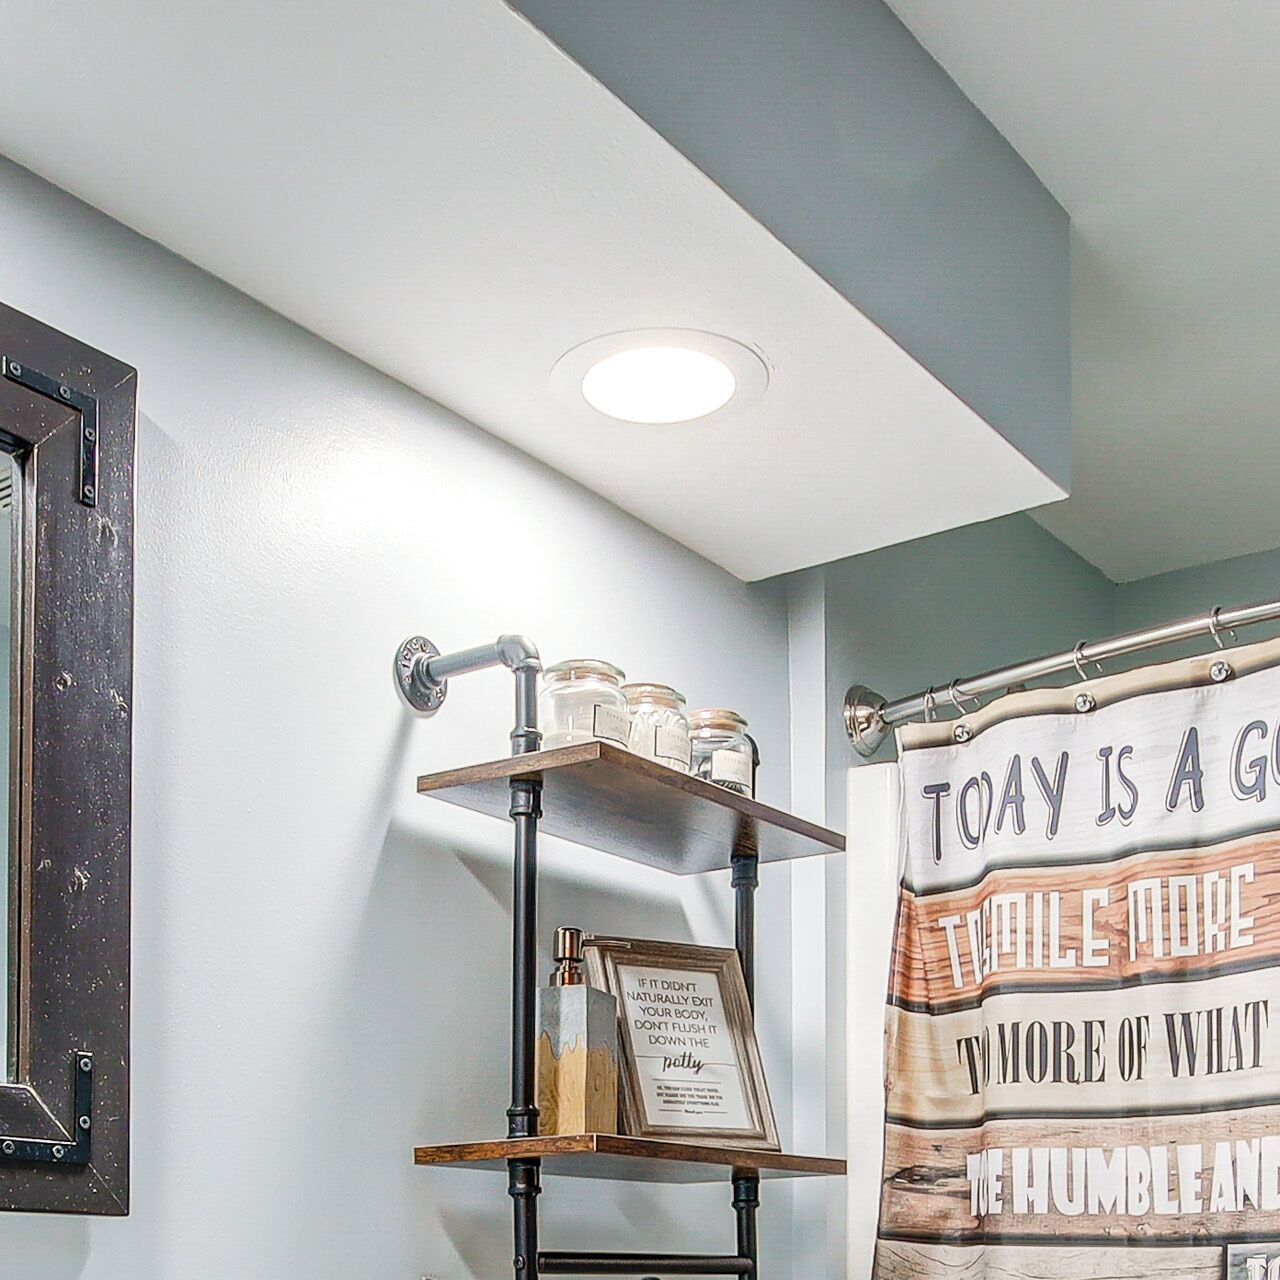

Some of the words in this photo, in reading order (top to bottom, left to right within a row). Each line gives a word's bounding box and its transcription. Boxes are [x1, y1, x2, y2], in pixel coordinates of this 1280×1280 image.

[1095, 745, 1138, 829] IS
[1167, 726, 1206, 814] A
[1127, 862, 1256, 963] MORE
[638, 978, 647, 988] IF
[650, 979, 658, 989] IT
[626, 991, 689, 1005] NATURALLY
[692, 996, 714, 1007] EXIT
[639, 1006, 672, 1018] YOUR
[674, 1009, 708, 1022] BODY,
[672, 1023, 707, 1034] FLUSH
[708, 1025, 717, 1035] IT
[648, 1035, 687, 1046] DOWN
[688, 1038, 710, 1048] THE
[996, 1018, 1107, 1086] MORE
[1118, 1015, 1152, 1083] OF
[1163, 1000, 1269, 1079] WHAT
[662, 1051, 704, 1075] potty
[1010, 1143, 1204, 1217] HUMBLE
